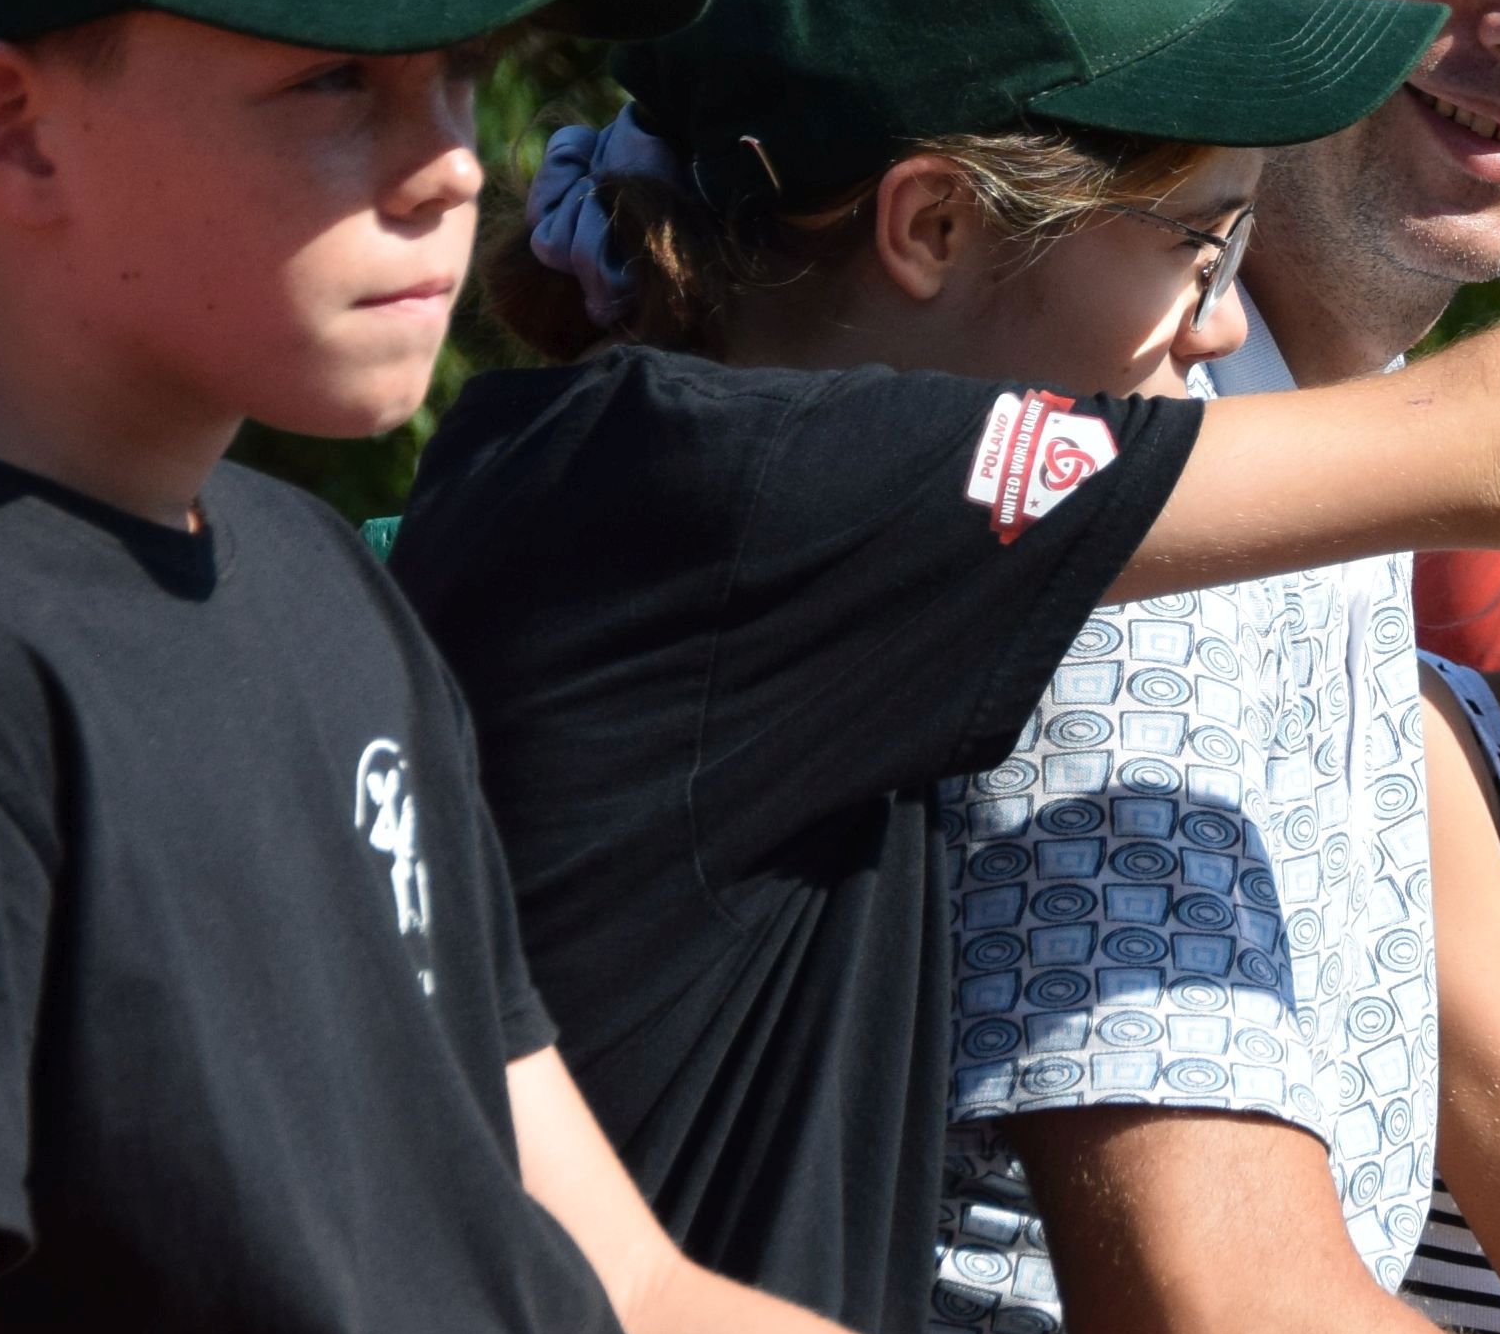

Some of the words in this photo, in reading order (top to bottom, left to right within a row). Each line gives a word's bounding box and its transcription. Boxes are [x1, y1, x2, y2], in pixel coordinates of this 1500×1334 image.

[1021, 399, 1045, 434] KARATE
[980, 413, 1009, 480] POLAND
[1010, 434, 1031, 475] WORLD
[1000, 477, 1021, 524] UNITED
